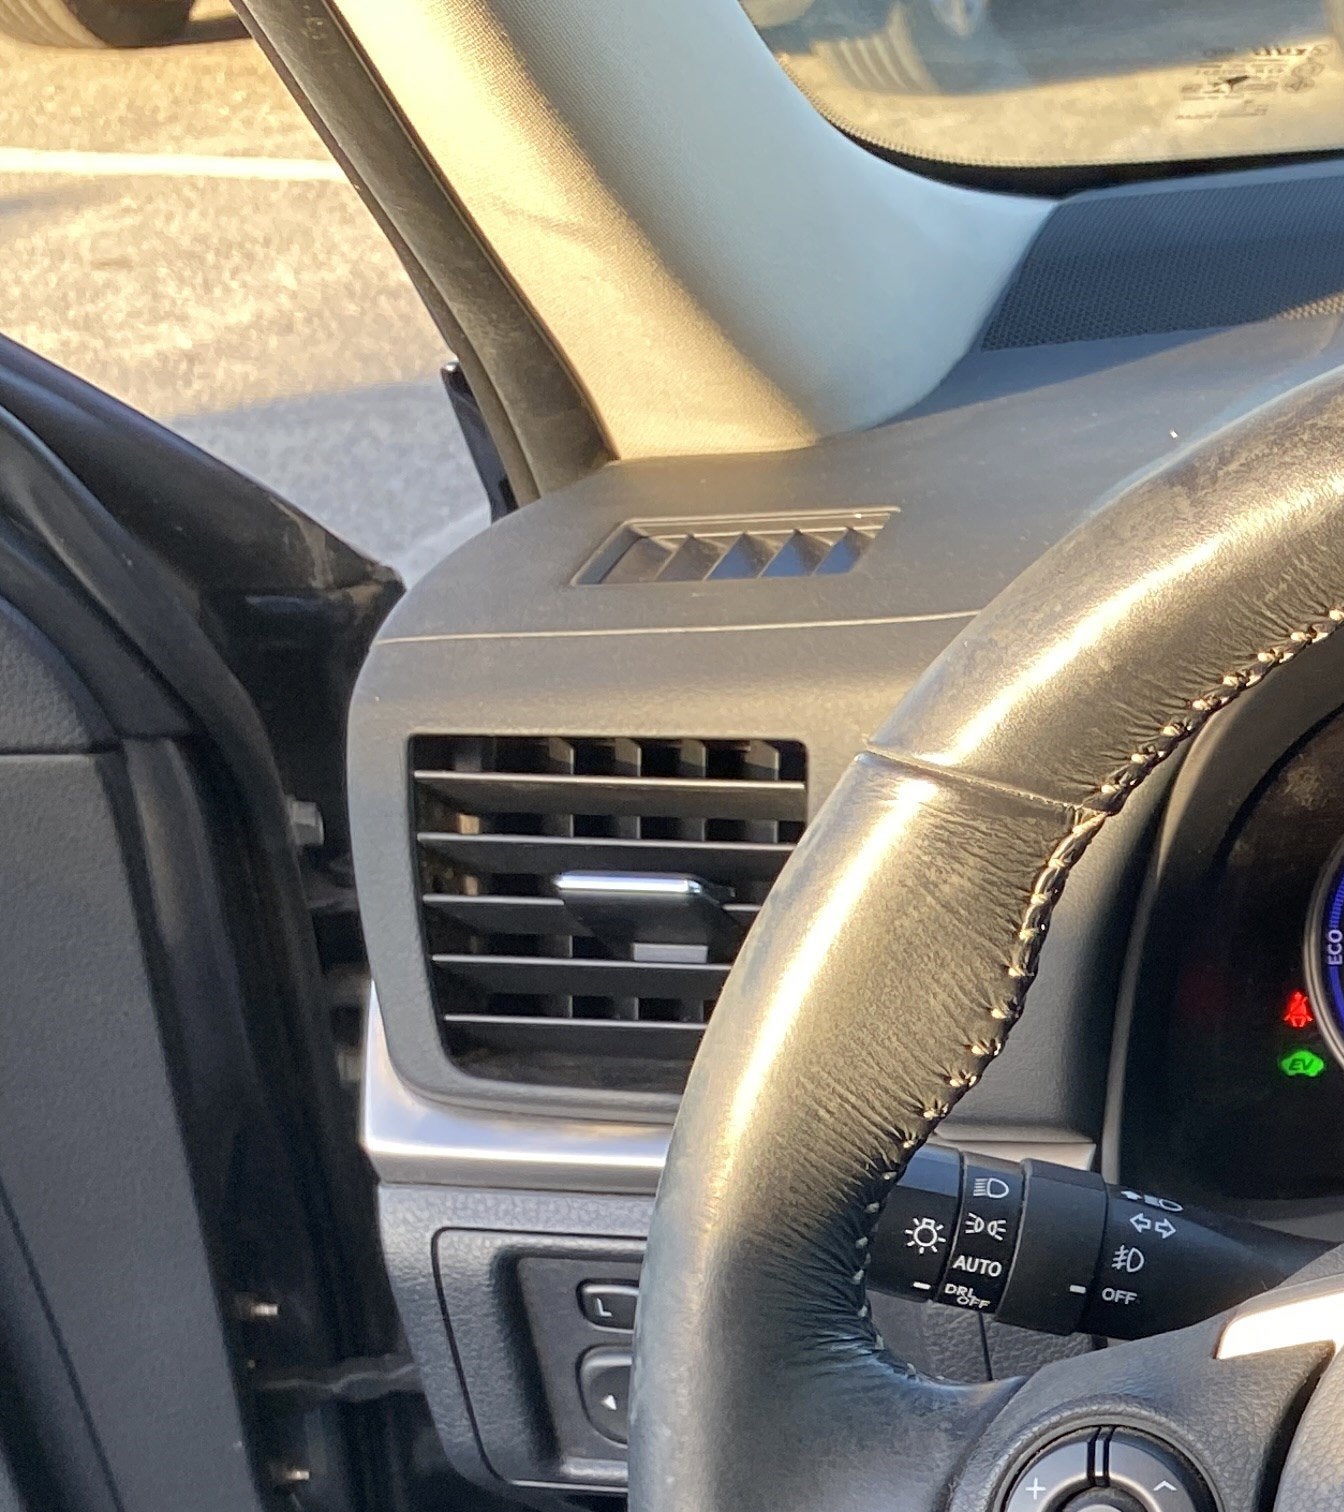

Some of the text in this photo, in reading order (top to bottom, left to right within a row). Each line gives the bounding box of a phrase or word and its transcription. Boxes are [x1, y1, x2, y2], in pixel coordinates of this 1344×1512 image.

[1327, 929, 1343, 966] ECO
[952, 1255, 1002, 1278] AUTO
[945, 1283, 976, 1301] DRL
[1102, 1288, 1138, 1305] OFF
[957, 1295, 990, 1310] OFF
